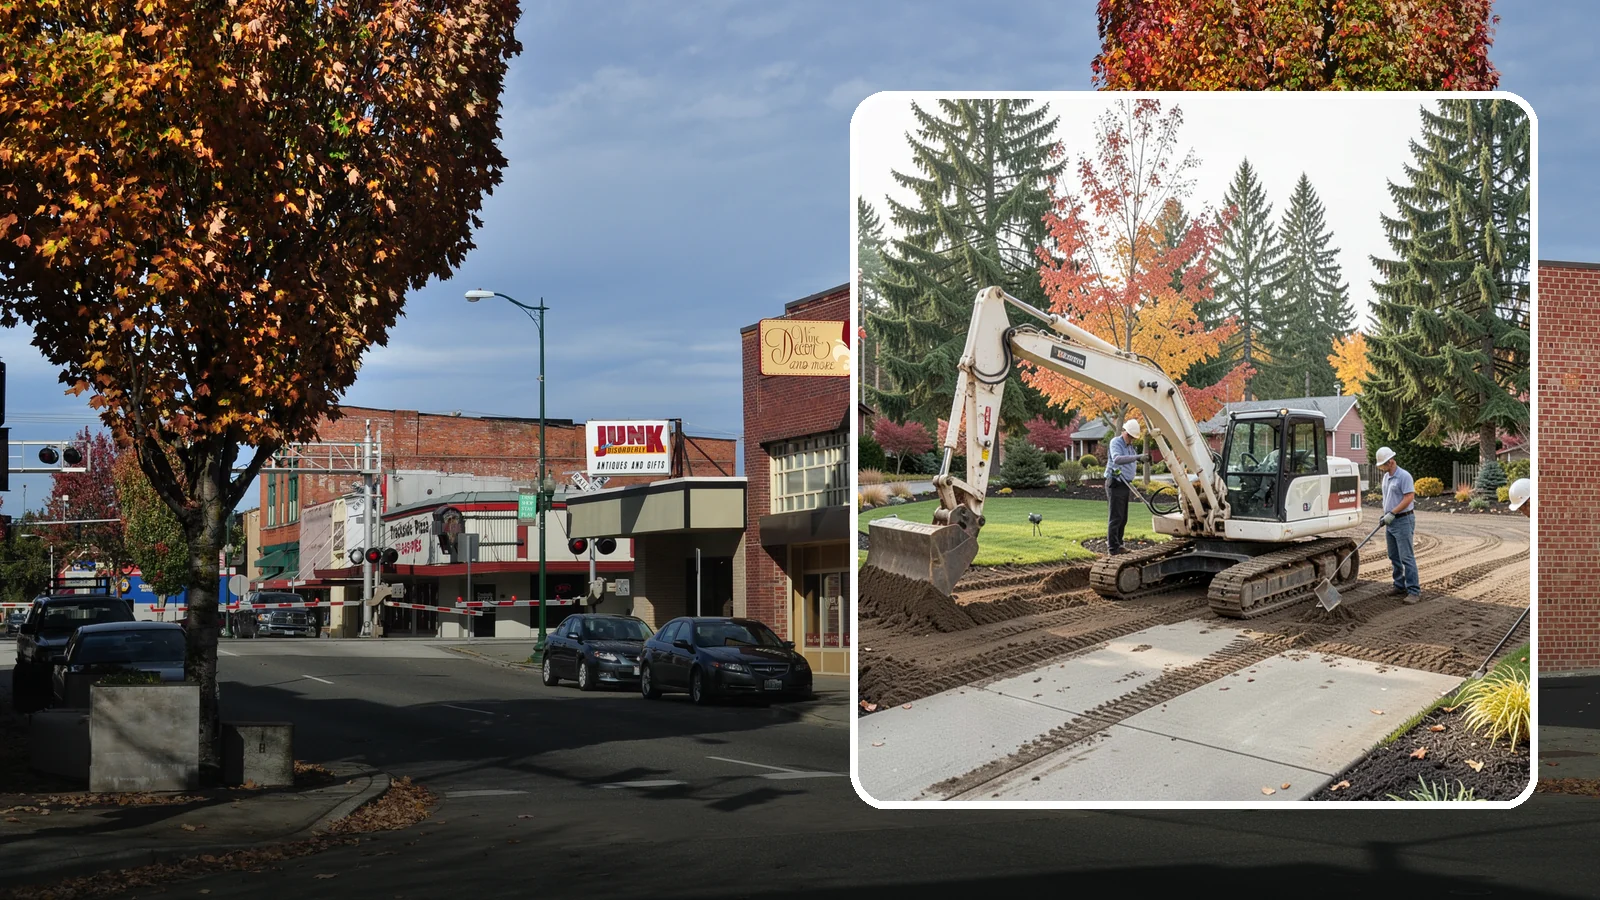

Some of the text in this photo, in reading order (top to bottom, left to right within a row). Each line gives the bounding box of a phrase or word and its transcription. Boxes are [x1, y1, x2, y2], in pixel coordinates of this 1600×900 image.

[596, 425, 665, 457] JUNK
[607, 446, 646, 454] DISORDERLY
[596, 460, 666, 470] ANTIQUES AND GIFTS
